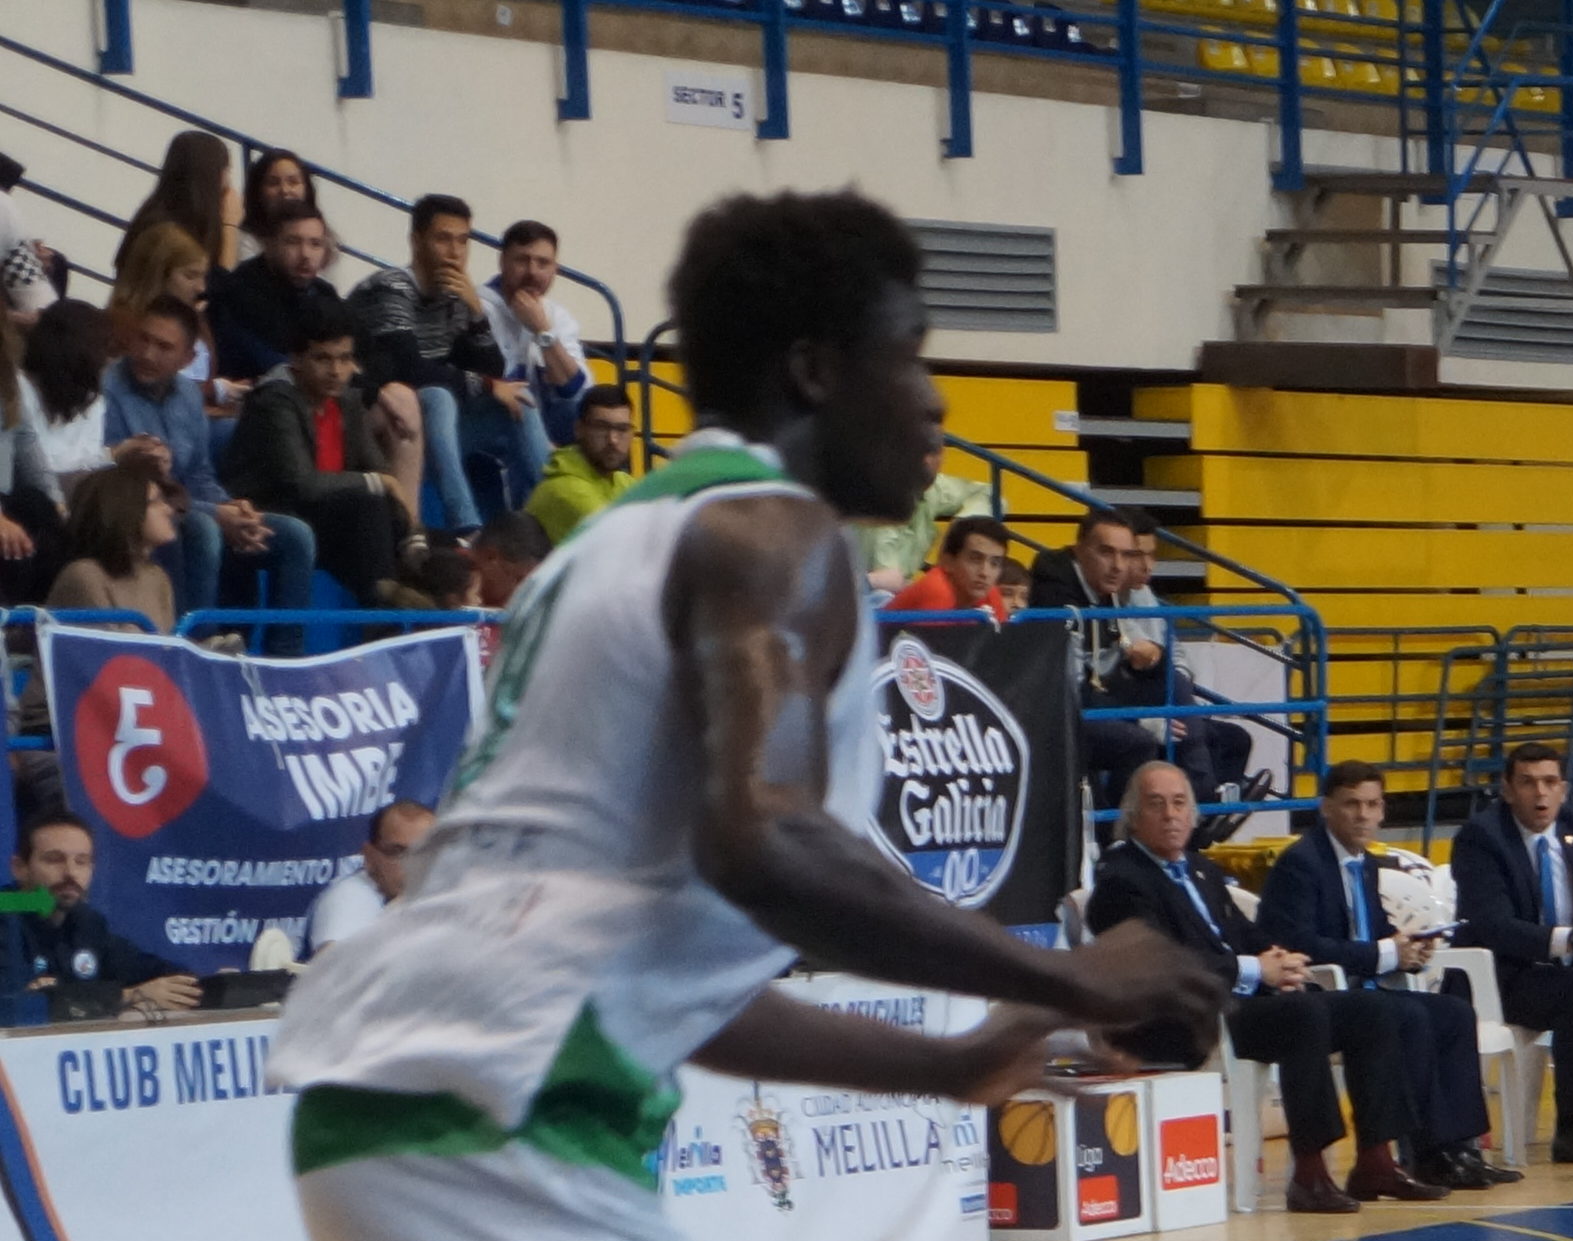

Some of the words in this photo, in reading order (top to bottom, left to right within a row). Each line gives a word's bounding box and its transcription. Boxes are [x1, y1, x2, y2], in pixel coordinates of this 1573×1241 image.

[732, 92, 745, 119] 5
[240, 681, 419, 742] ASESORIA
[900, 779, 1007, 846] Galicia
[146, 856, 334, 886] ASESORAMIENTO
[57, 1045, 161, 1115] CLUB
[174, 1034, 300, 1106] MELI
[812, 1118, 942, 1178] MELILLA
